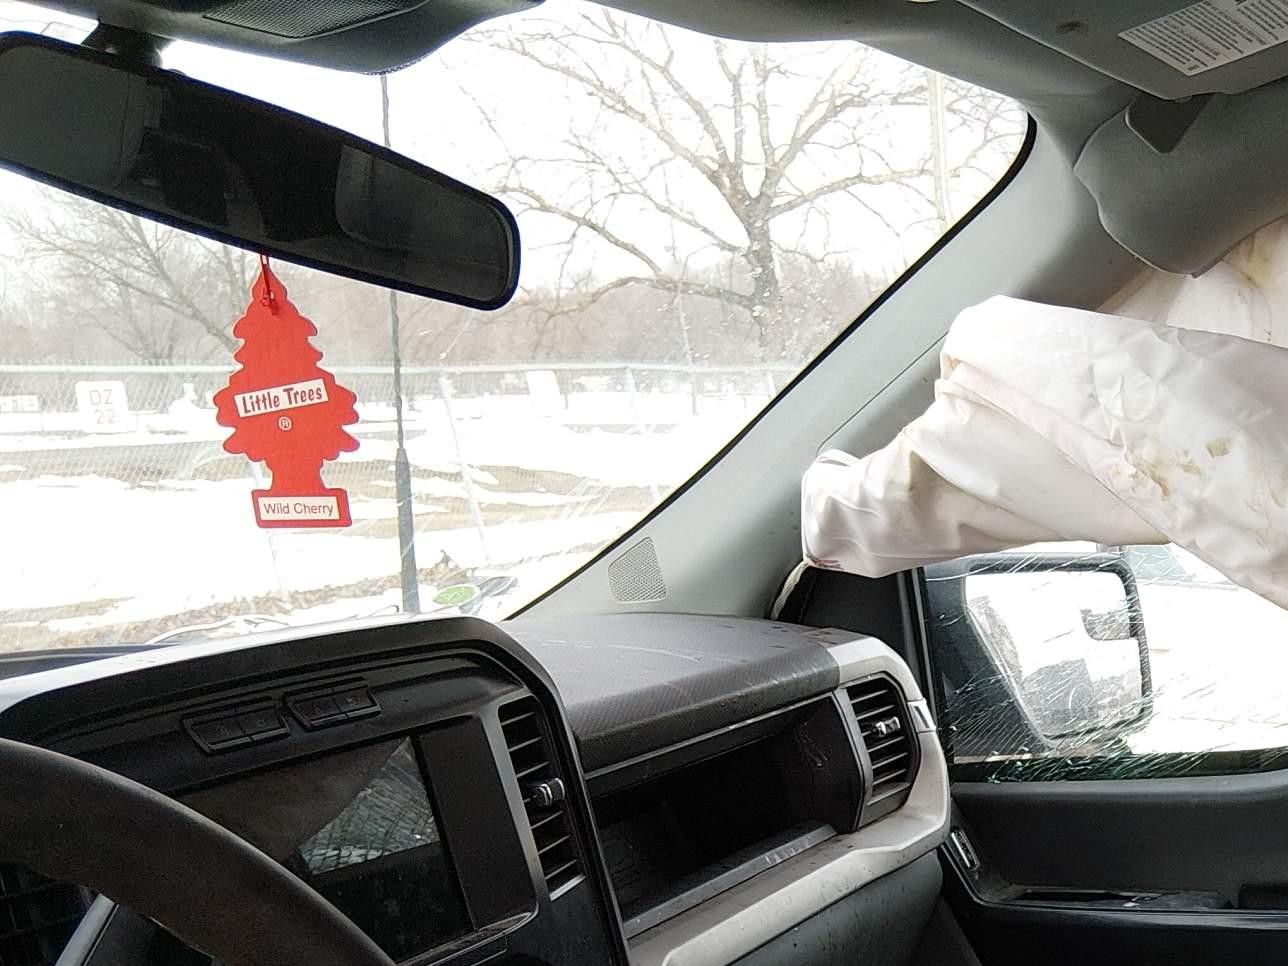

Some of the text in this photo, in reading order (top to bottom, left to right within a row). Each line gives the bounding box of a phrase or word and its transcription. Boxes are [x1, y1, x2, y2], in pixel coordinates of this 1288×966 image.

[242, 387, 323, 414] Little Trees
[94, 408, 117, 425] 22
[263, 502, 334, 517] Wild Cherry
